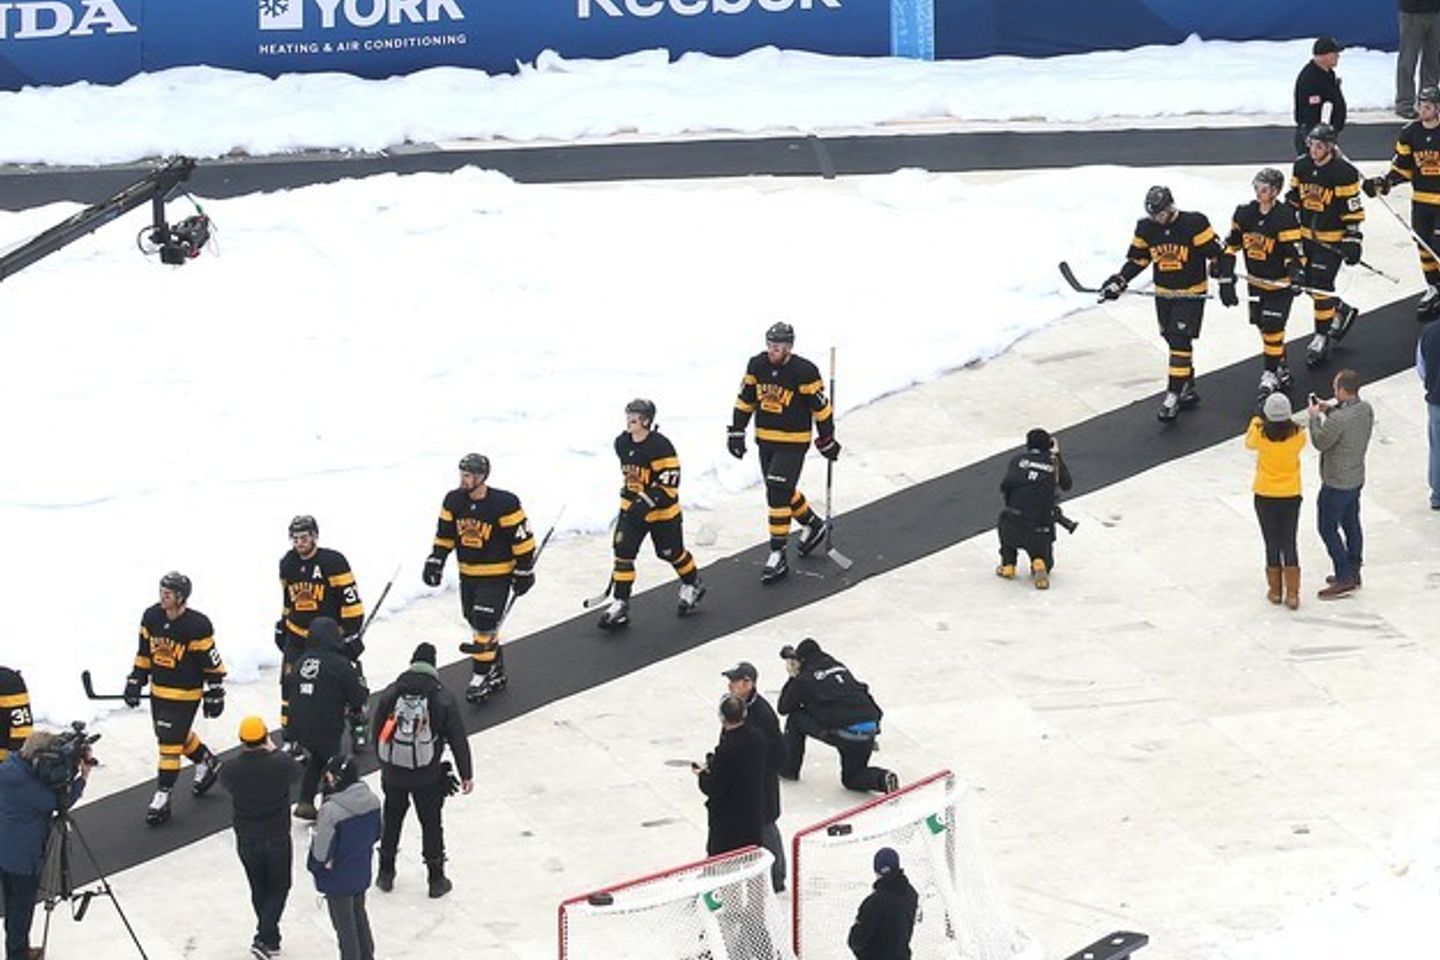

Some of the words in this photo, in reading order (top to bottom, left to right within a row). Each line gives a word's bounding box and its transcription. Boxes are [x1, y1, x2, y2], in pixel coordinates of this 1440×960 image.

[259, 43, 319, 54] HEATING
[322, 43, 333, 53] &
[336, 41, 360, 52] AIR
[364, 34, 467, 50] CONDITIONING
[658, 470, 680, 488] 47
